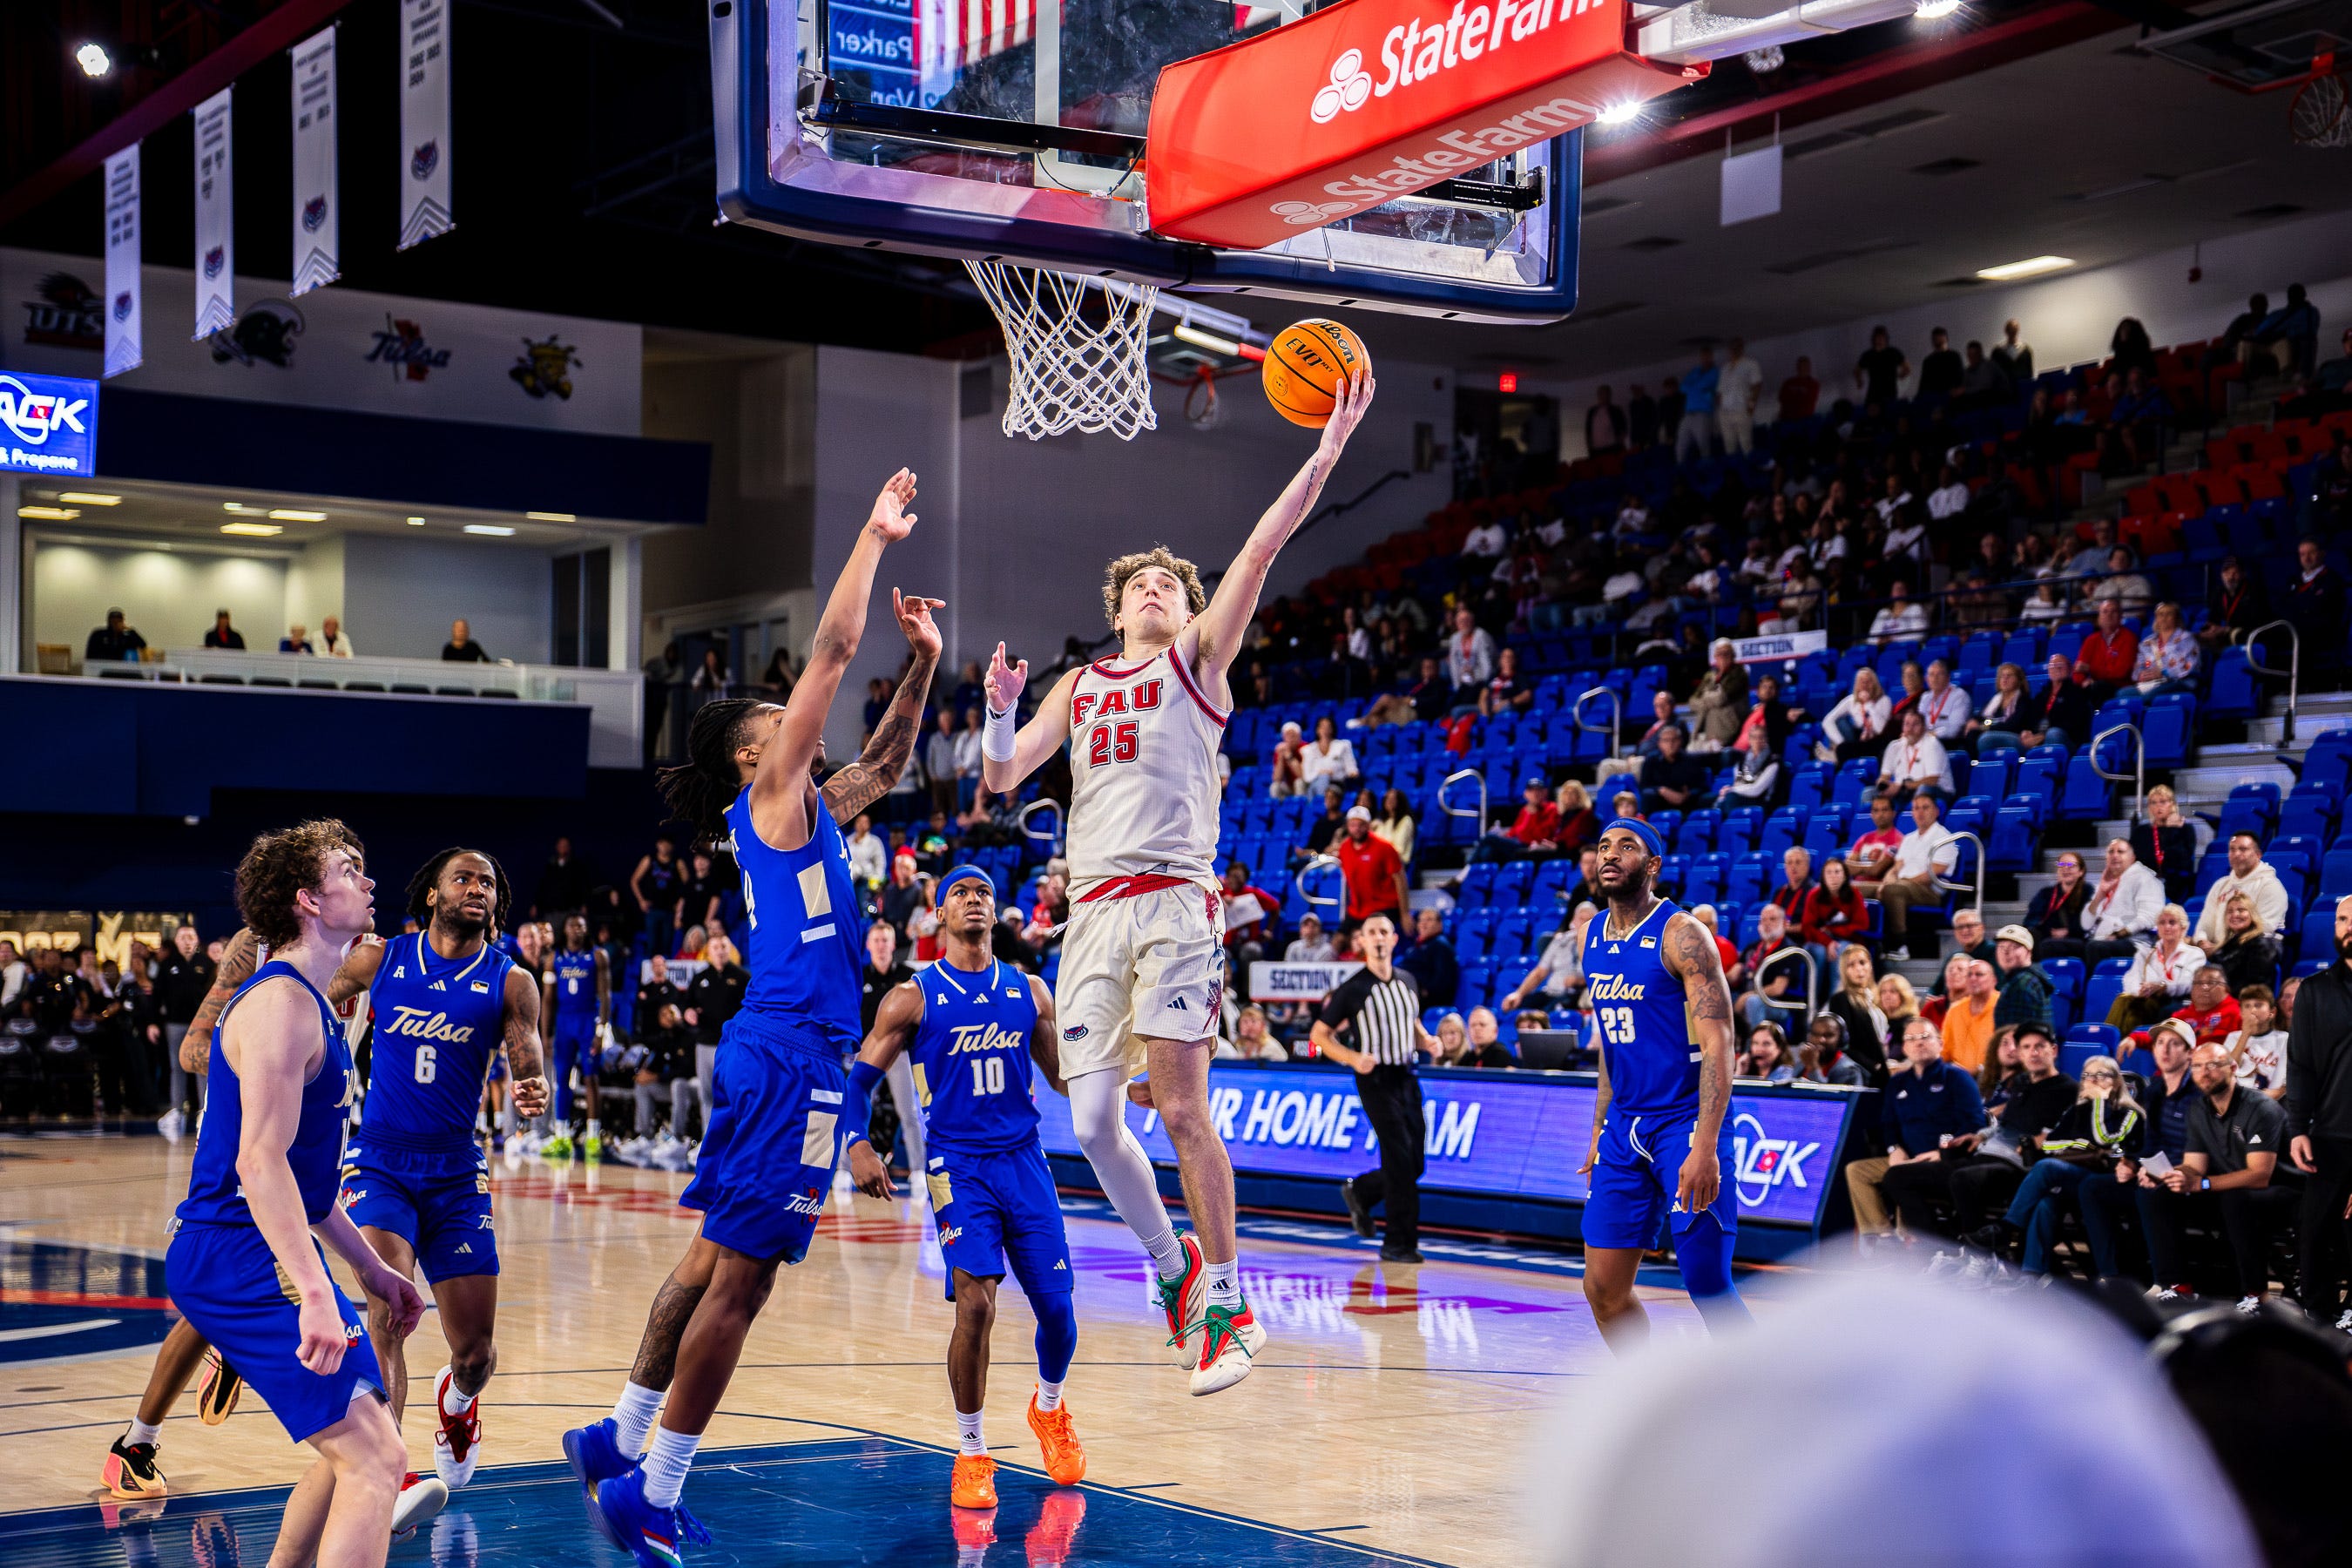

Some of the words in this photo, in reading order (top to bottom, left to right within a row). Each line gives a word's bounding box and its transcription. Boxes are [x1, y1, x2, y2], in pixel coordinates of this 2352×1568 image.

[11, 448, 78, 470] Propane
[1071, 678, 1163, 728] FAU
[1090, 720, 1139, 769] 25
[1270, 969, 1333, 990] SECTION
[1588, 972, 1646, 1001] Tulsa
[384, 1005, 475, 1043] Tulsa
[948, 1022, 1024, 1056] Tulsa
[1600, 1006, 1636, 1044] 23
[414, 1044, 436, 1084] 6
[970, 1056, 1005, 1097] 10
[1242, 1089, 1360, 1149] HOME
